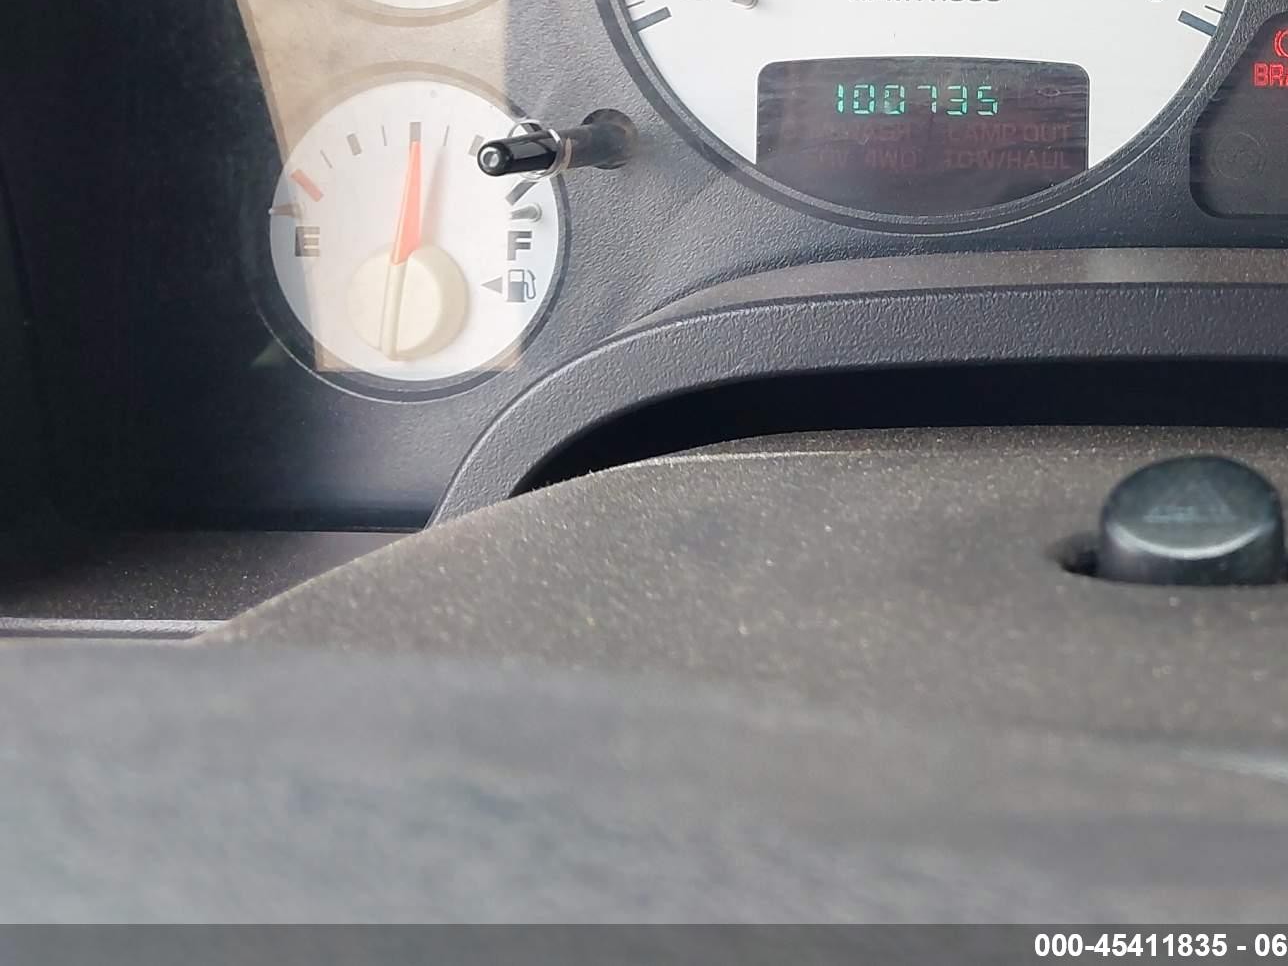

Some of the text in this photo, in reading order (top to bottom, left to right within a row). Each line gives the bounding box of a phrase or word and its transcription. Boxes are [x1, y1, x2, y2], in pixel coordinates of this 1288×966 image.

[835, 83, 998, 116] 100735
[294, 227, 321, 256] E
[507, 230, 533, 261] F
